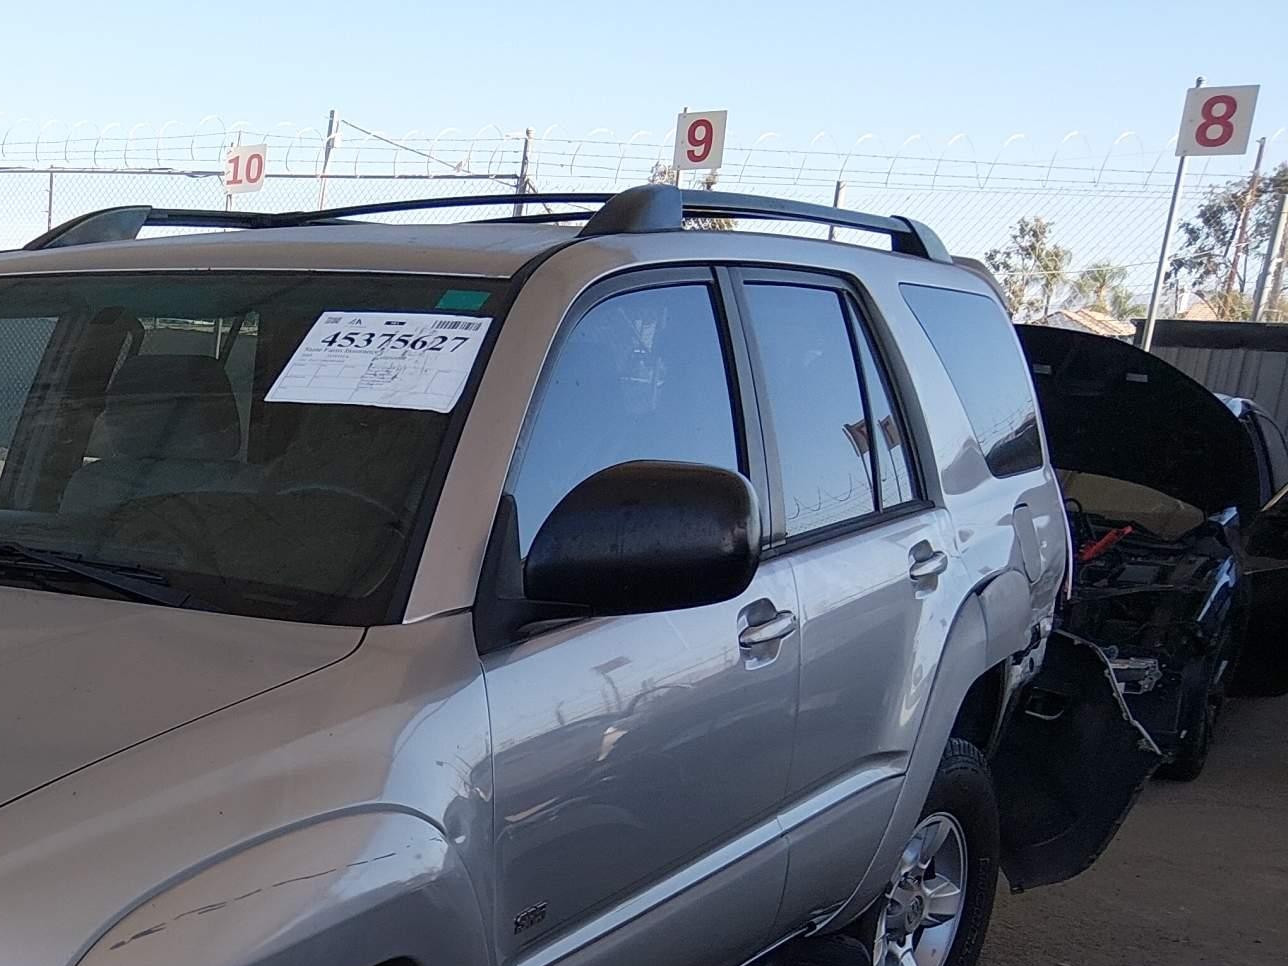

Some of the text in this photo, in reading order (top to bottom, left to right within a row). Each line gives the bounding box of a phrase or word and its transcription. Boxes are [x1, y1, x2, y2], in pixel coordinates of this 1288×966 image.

[686, 118, 714, 163] 9
[1195, 94, 1238, 148] 8
[226, 153, 263, 186] 10
[321, 330, 470, 353] 45375627
